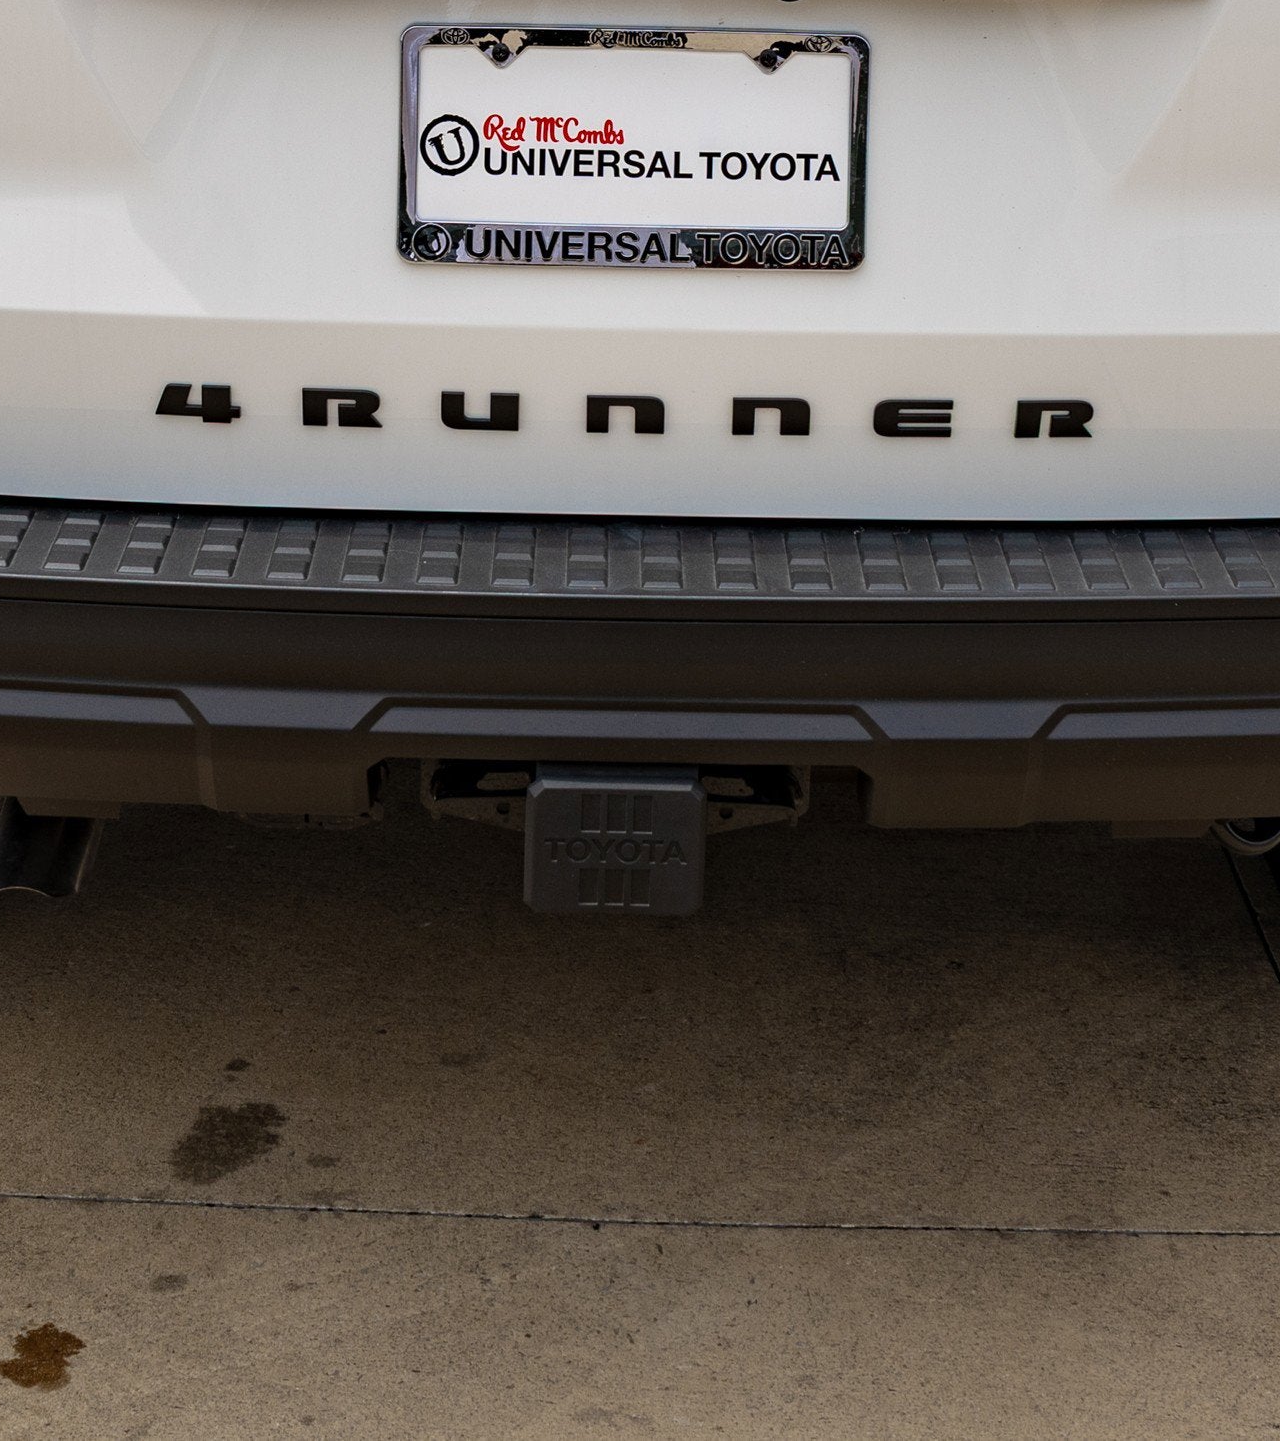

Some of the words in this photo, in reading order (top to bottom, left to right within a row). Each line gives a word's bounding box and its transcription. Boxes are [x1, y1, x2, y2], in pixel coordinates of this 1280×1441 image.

[483, 114, 525, 151] Red
[530, 116, 624, 145] McCombs
[484, 148, 693, 179] UNIVERSAL
[699, 151, 841, 181] TOYOTA
[466, 228, 692, 264] UNIVERSAL
[696, 231, 849, 266] TOYOTA
[544, 838, 687, 865] TOYOTA
